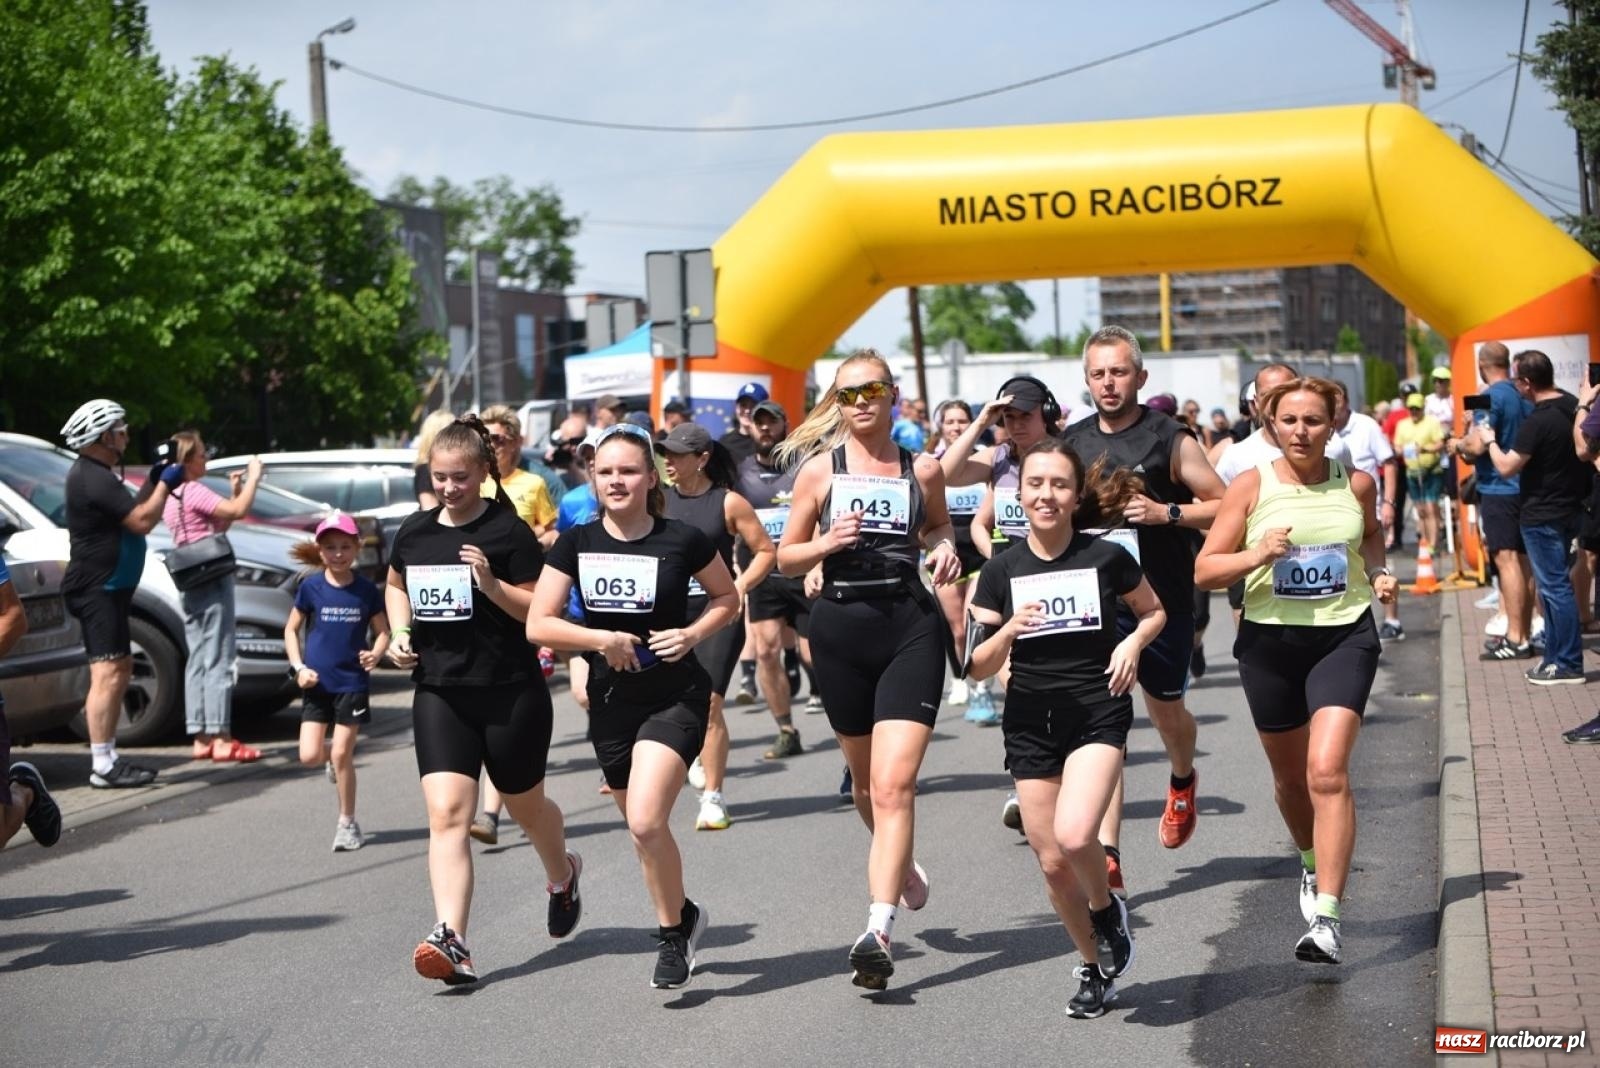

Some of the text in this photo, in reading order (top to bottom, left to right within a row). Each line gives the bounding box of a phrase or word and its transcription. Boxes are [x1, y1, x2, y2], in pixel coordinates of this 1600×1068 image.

[939, 174, 1283, 225] MIASTO RACIBÓRZ
[850, 498, 891, 518] 043
[955, 495, 978, 506] 032
[1005, 504, 1024, 518] 00
[1291, 565, 1333, 585] 004
[419, 588, 454, 606] 054
[595, 577, 636, 597] 063
